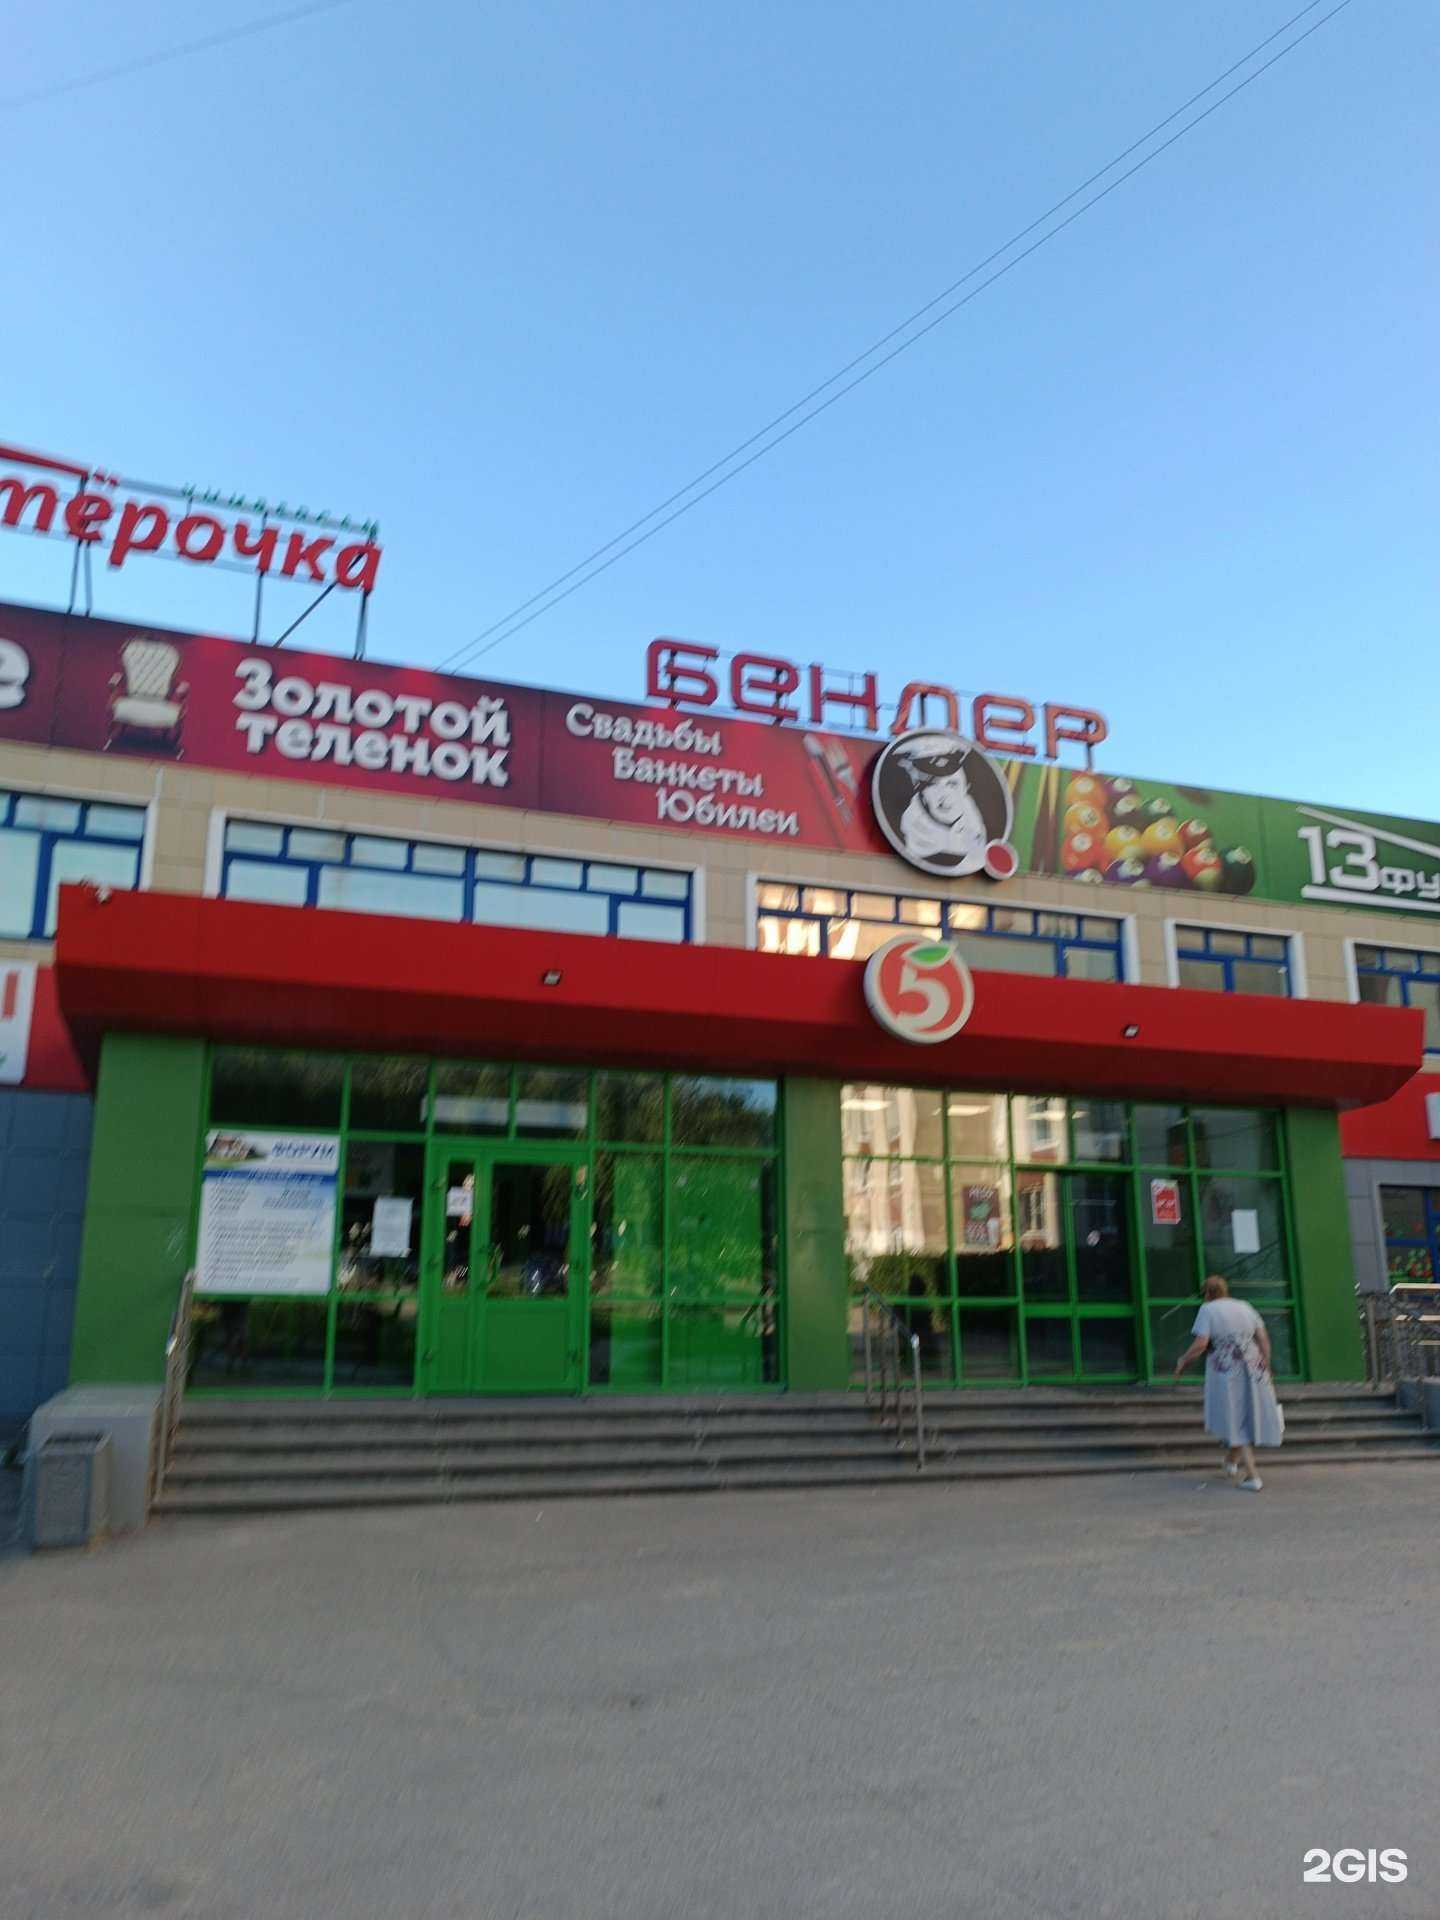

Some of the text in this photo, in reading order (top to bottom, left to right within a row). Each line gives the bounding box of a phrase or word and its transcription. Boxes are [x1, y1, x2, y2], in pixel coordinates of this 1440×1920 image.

[233, 657, 511, 748] Золотой
[565, 702, 722, 756] Свадьбы
[235, 711, 509, 788] теленок
[612, 746, 764, 798] Банкеты
[655, 786, 800, 837] Юбилеи
